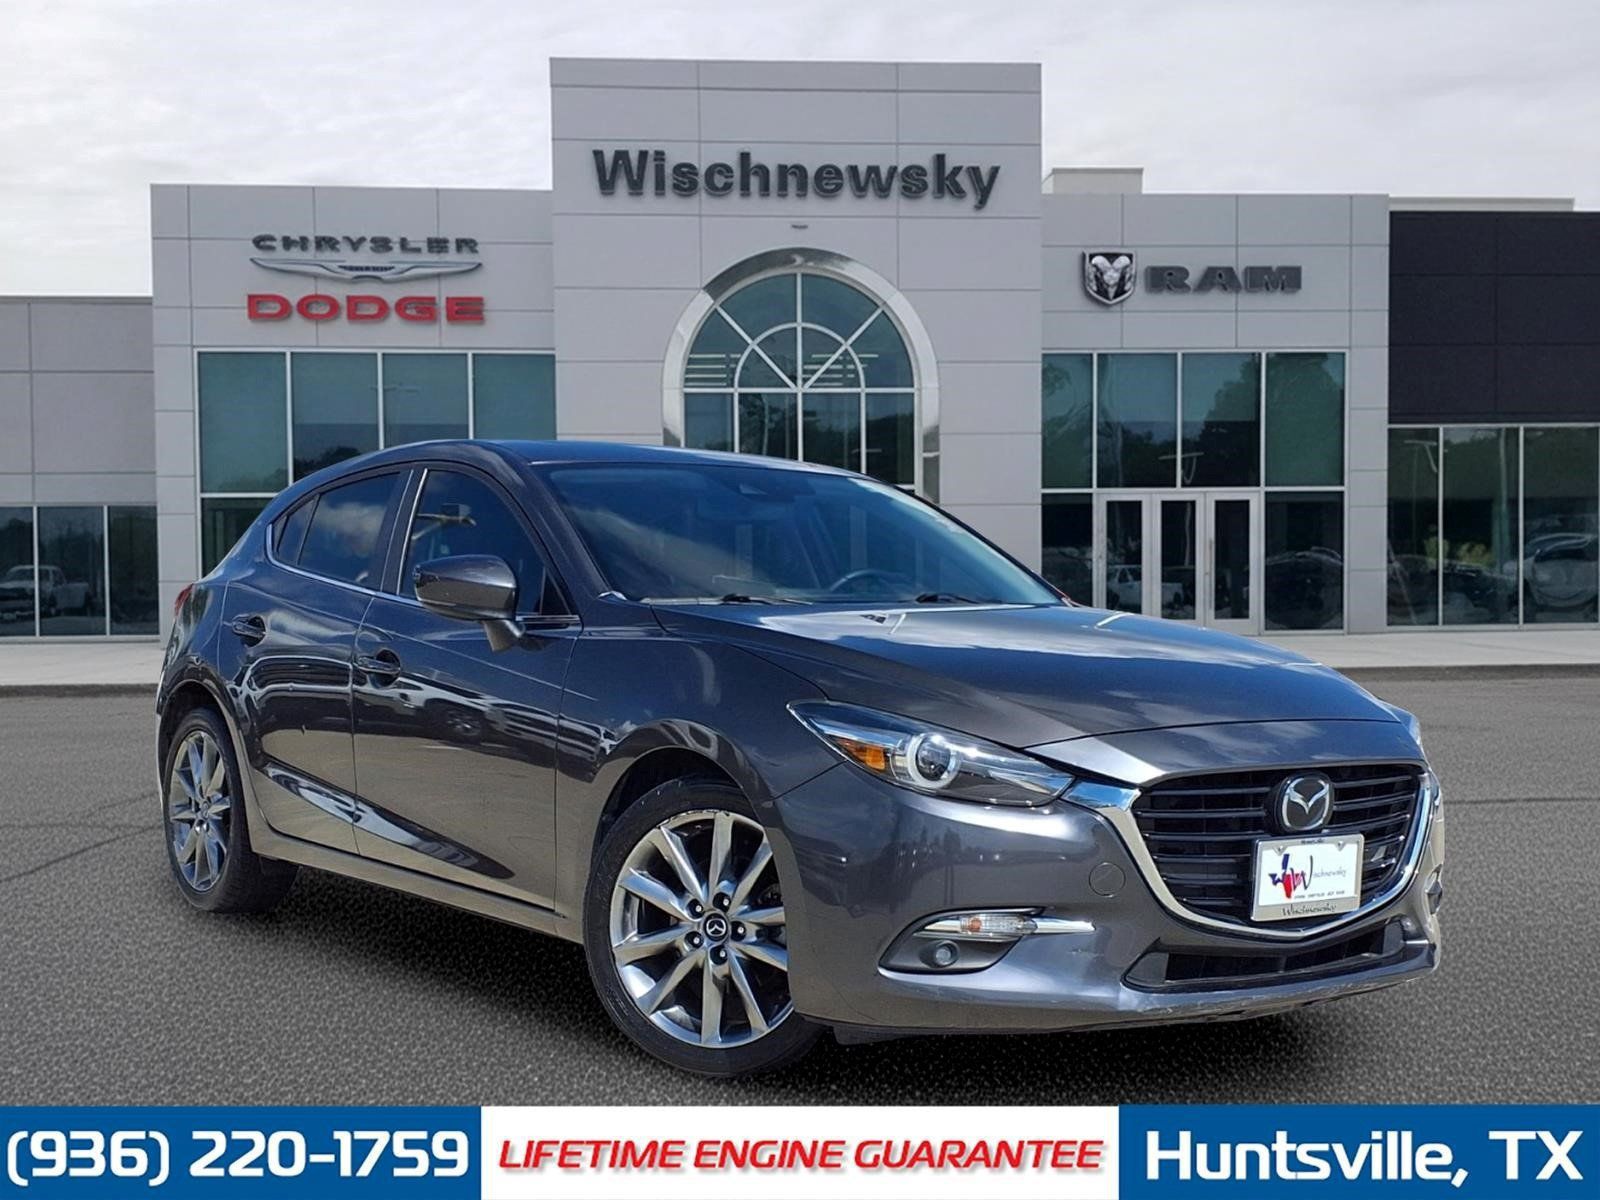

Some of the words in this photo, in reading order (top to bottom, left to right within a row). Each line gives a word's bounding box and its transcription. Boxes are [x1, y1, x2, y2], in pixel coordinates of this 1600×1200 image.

[593, 149, 1000, 210] Wischnewsky
[252, 234, 479, 254] CHRYSLER
[1145, 266, 1302, 294] RAM
[247, 294, 484, 323] DODGE
